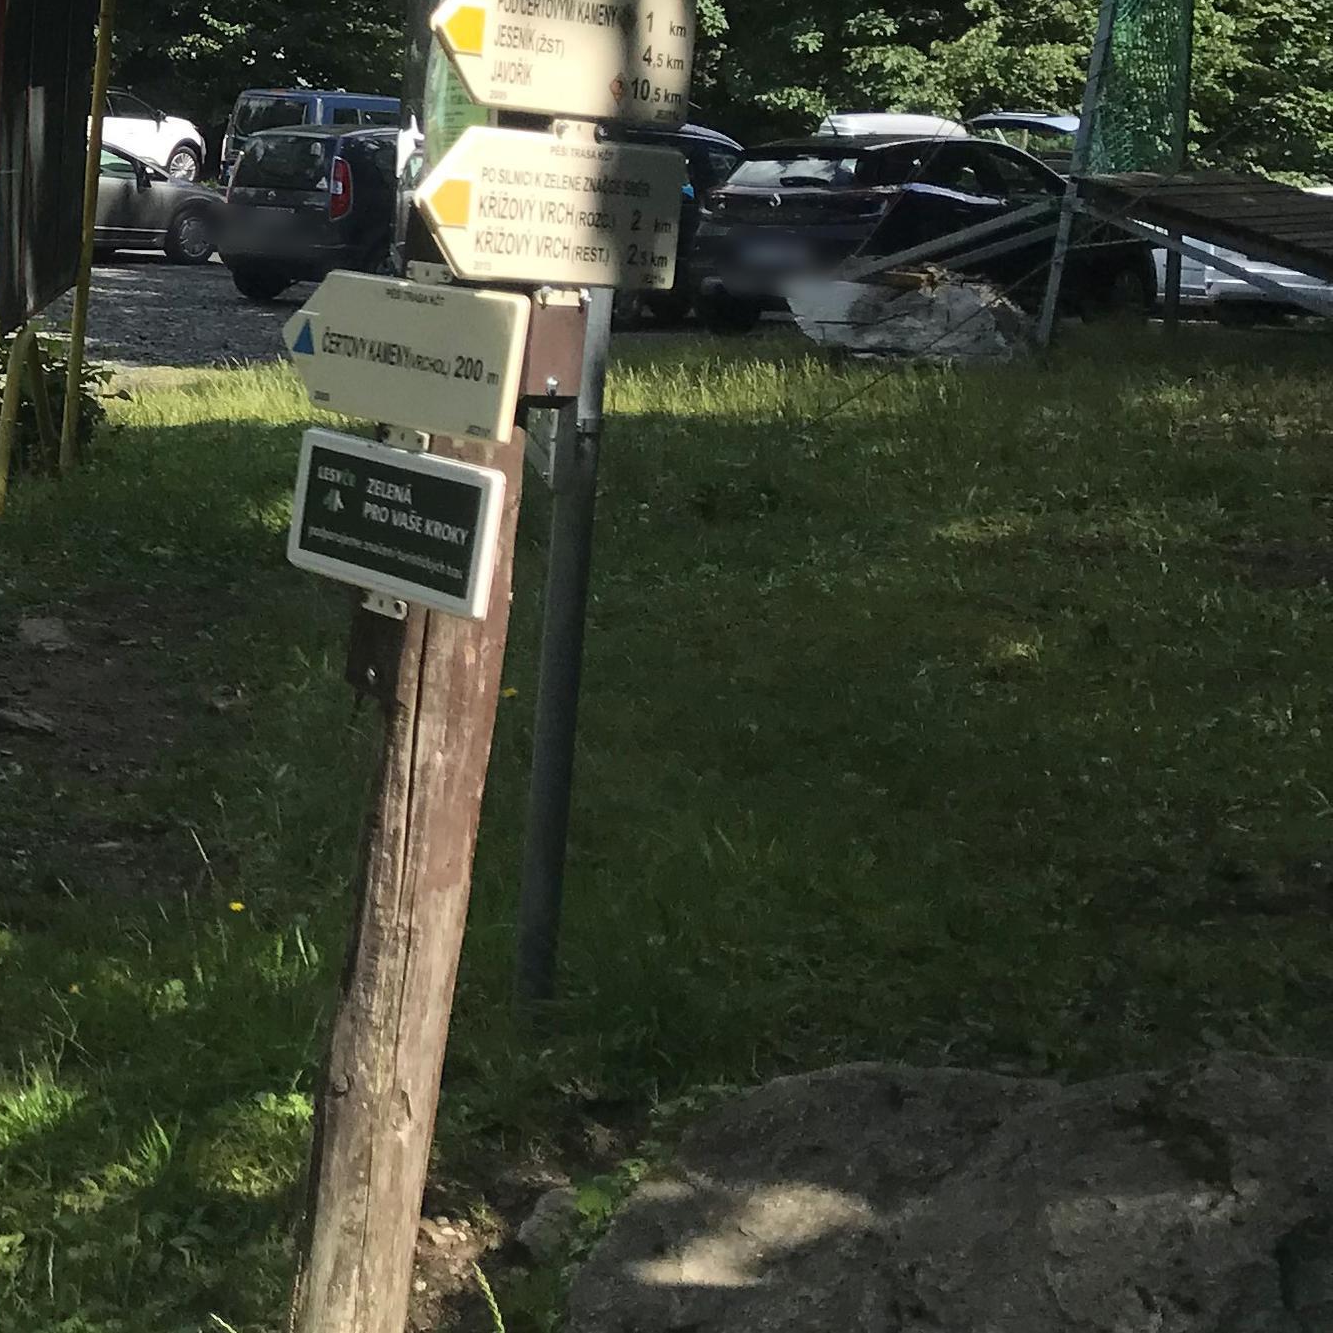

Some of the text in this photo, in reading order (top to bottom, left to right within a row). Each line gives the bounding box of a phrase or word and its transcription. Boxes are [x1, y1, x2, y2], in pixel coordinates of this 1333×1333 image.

[577, 3, 619, 28] KAMENY
[645, 11, 654, 33] 1
[669, 19, 687, 38] km
[494, 21, 535, 51] JESENÍK
[642, 44, 664, 68] 4,5
[667, 50, 684, 69] km
[631, 76, 661, 102] 10,5
[664, 86, 682, 105] km
[482, 167, 497, 183] PO
[535, 172, 542, 187] K
[479, 189, 534, 222] KŘÍŽOVÝ
[630, 211, 642, 232] 2
[653, 218, 672, 234] km
[475, 224, 532, 257] KŘÍŽOVÝ
[650, 252, 668, 268] km
[454, 356, 484, 382] 200
[487, 371, 499, 385] m
[366, 477, 413, 505] ZELENÁ
[363, 501, 469, 547] PRO VAŠE KROKY
